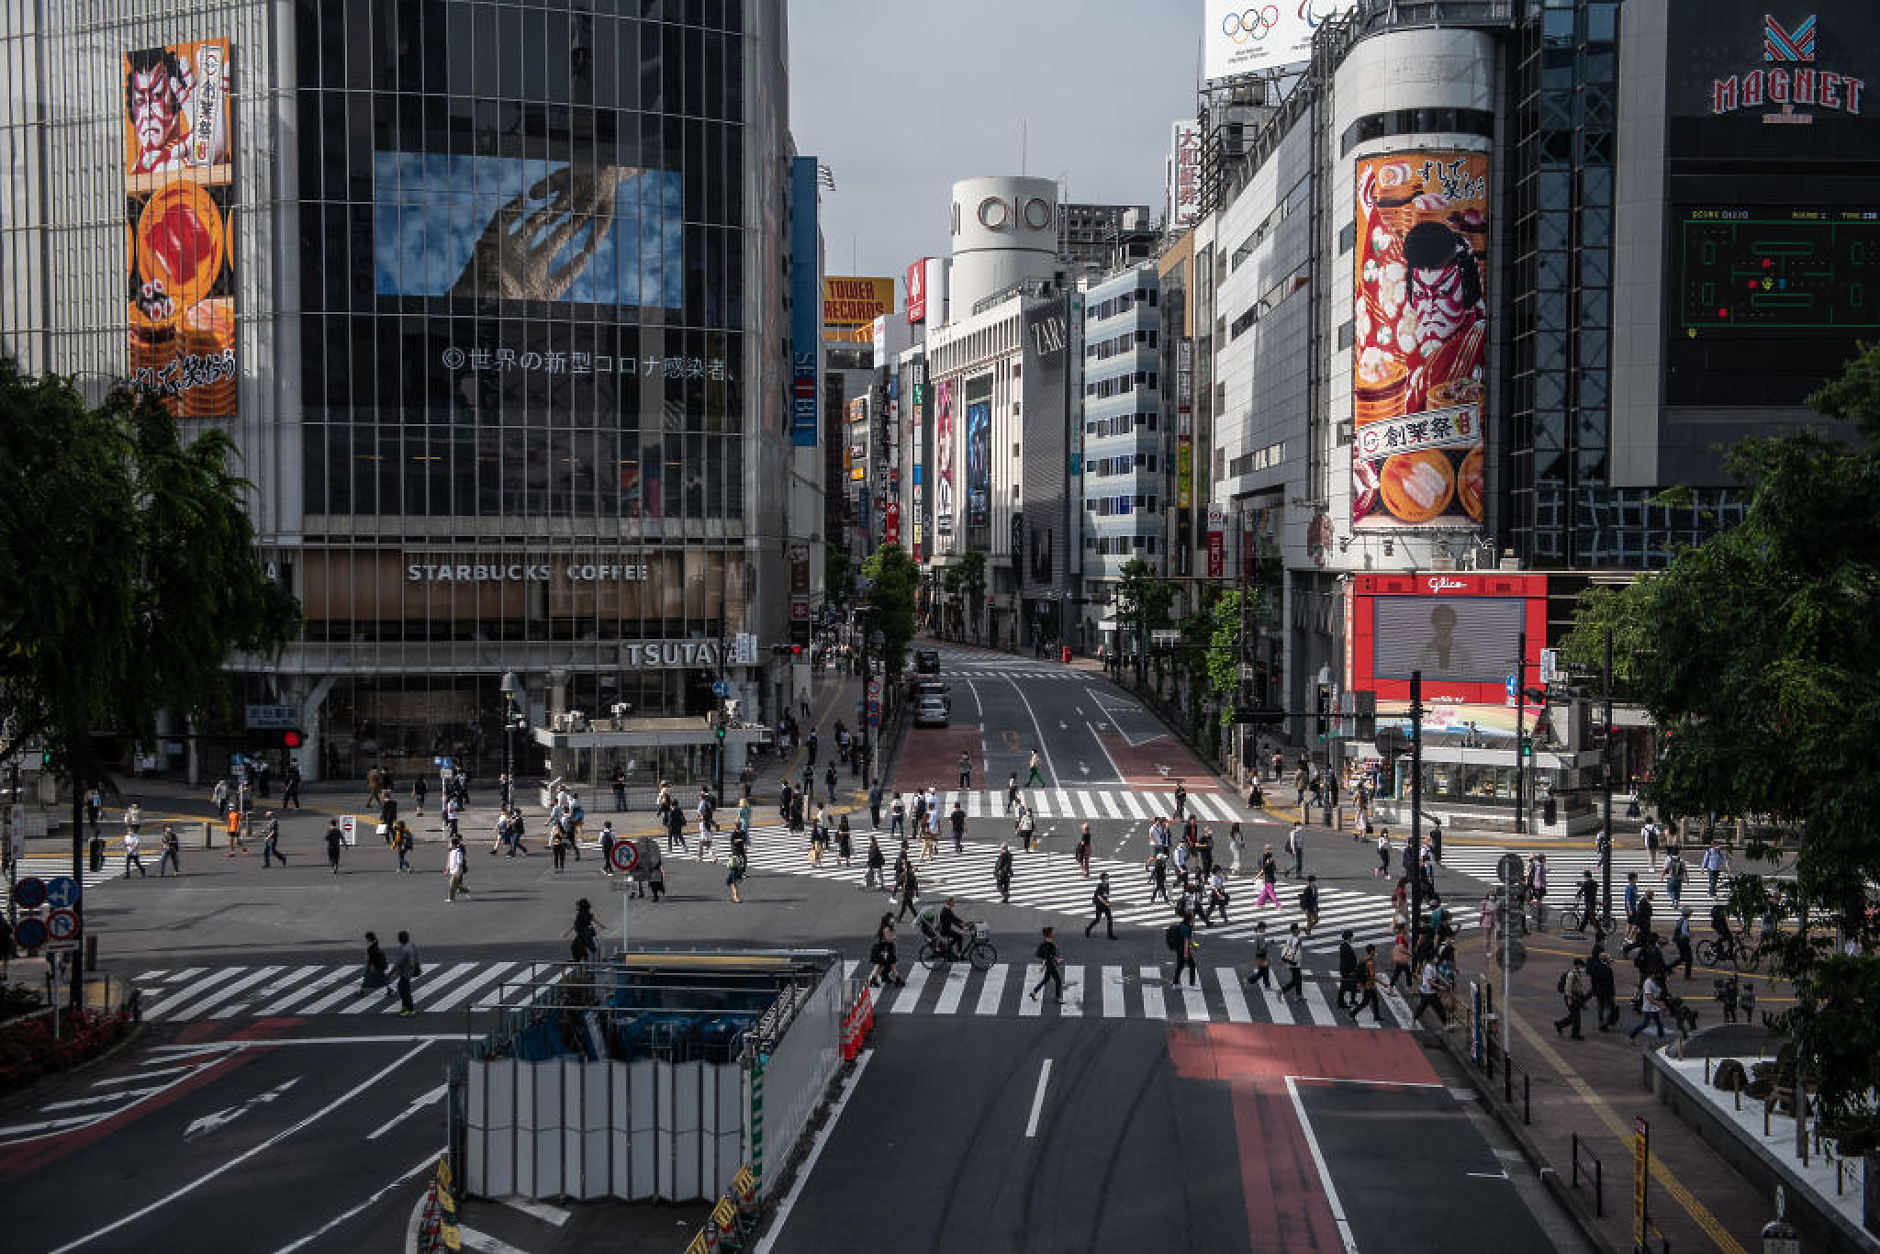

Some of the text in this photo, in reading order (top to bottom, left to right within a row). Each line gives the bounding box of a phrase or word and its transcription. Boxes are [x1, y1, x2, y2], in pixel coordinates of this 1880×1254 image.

[1713, 68, 1865, 114] MAGNET
[828, 280, 875, 300] TOWER
[824, 300, 884, 320] RECORDS
[407, 564, 648, 581] STARBUCKS COFFEE
[1427, 576, 1468, 593] Glico
